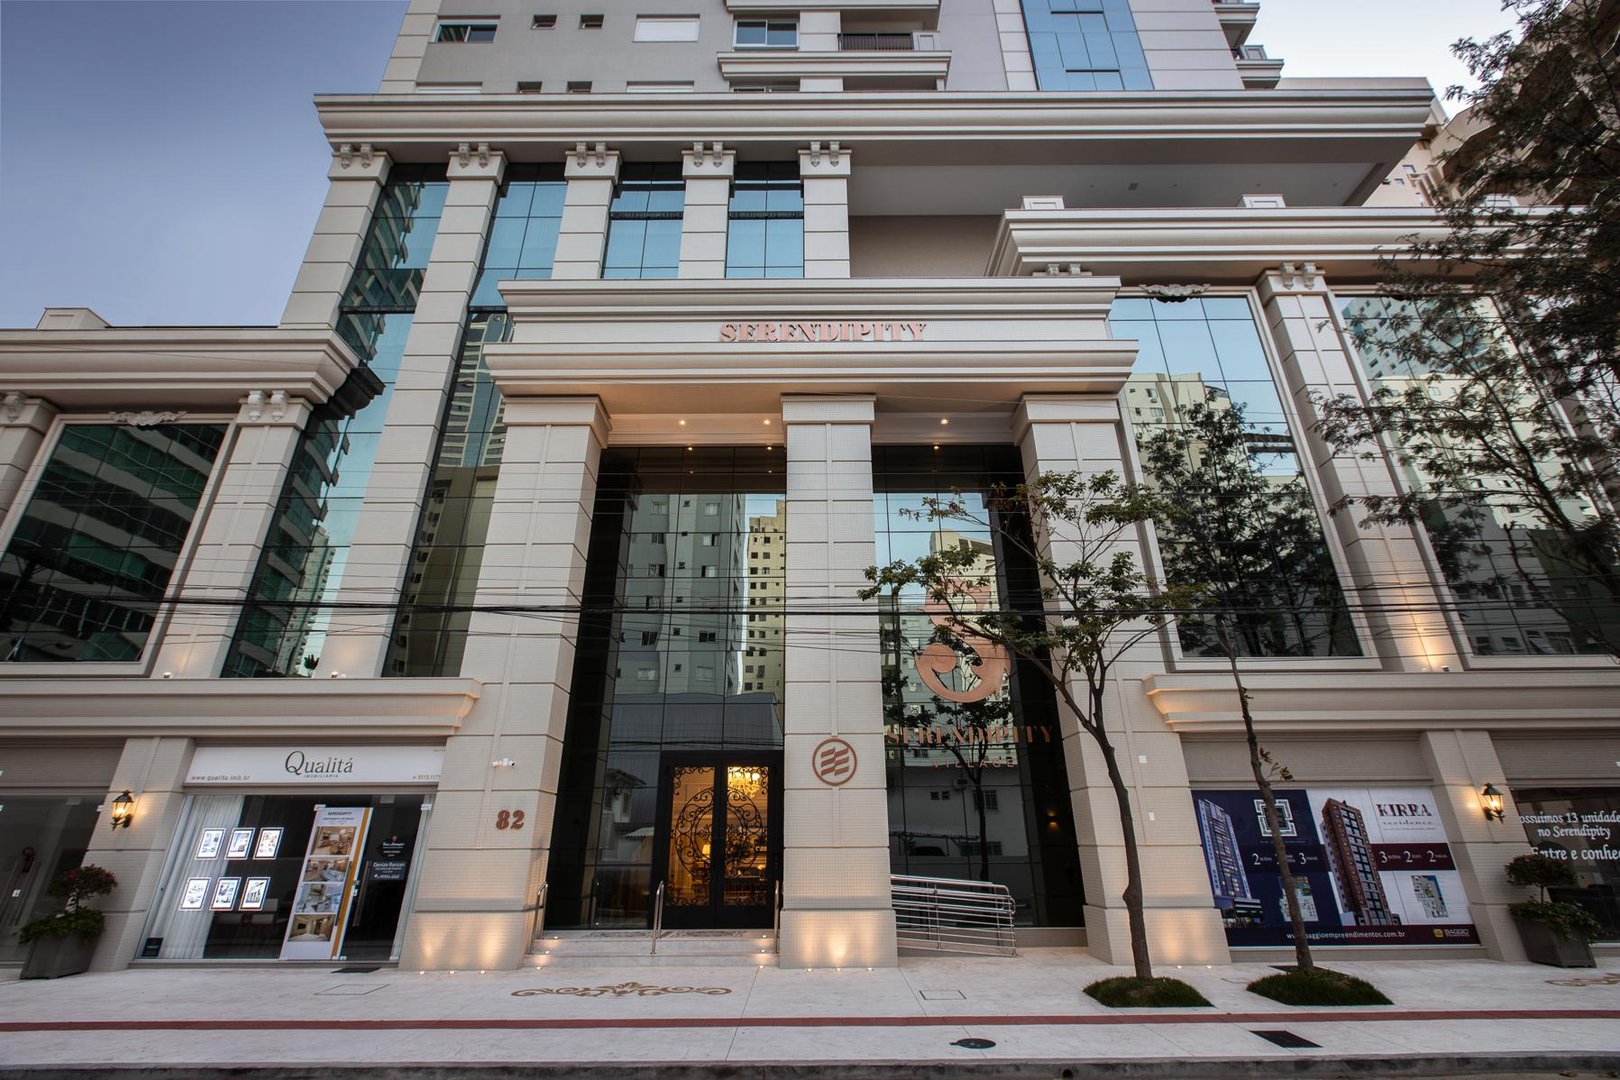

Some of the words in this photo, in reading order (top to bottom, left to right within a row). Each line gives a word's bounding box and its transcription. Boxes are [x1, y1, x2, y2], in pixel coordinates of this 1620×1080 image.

[719, 320, 927, 342] SERENDIPITY
[284, 750, 353, 776] Qualitá
[932, 759, 1015, 768] VILLAGE
[1376, 803, 1432, 817] KIRRA
[1519, 810, 1564, 824] ossuímos
[1565, 812, 1578, 823] 13
[496, 810, 525, 830] 82
[1537, 828, 1551, 837] no
[1553, 824, 1611, 840] Serendipity
[1571, 849, 1578, 860] e
[1581, 844, 1620, 860] conhe
[1286, 930, 1406, 941] waggioempreendimentos.com.br
